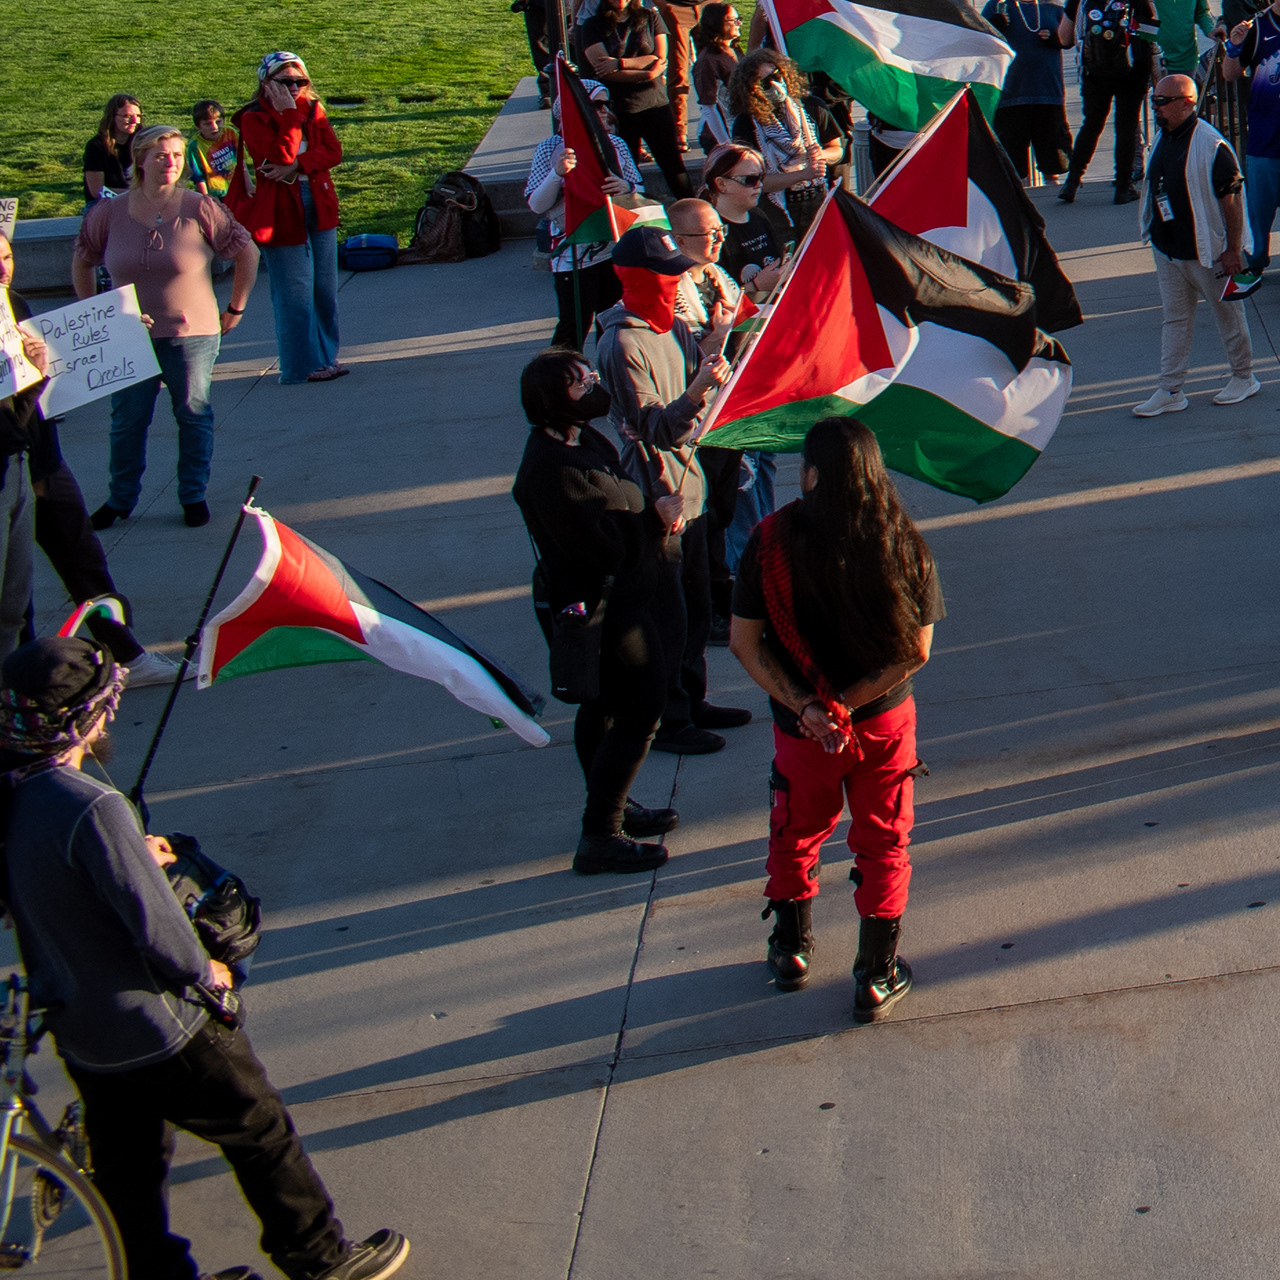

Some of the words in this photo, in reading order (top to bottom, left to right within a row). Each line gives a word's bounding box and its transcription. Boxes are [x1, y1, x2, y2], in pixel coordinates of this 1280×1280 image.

[40, 304, 116, 344] Palestine
[72, 324, 110, 347] Rules
[49, 347, 104, 379] Israel
[87, 357, 135, 389] Drools
